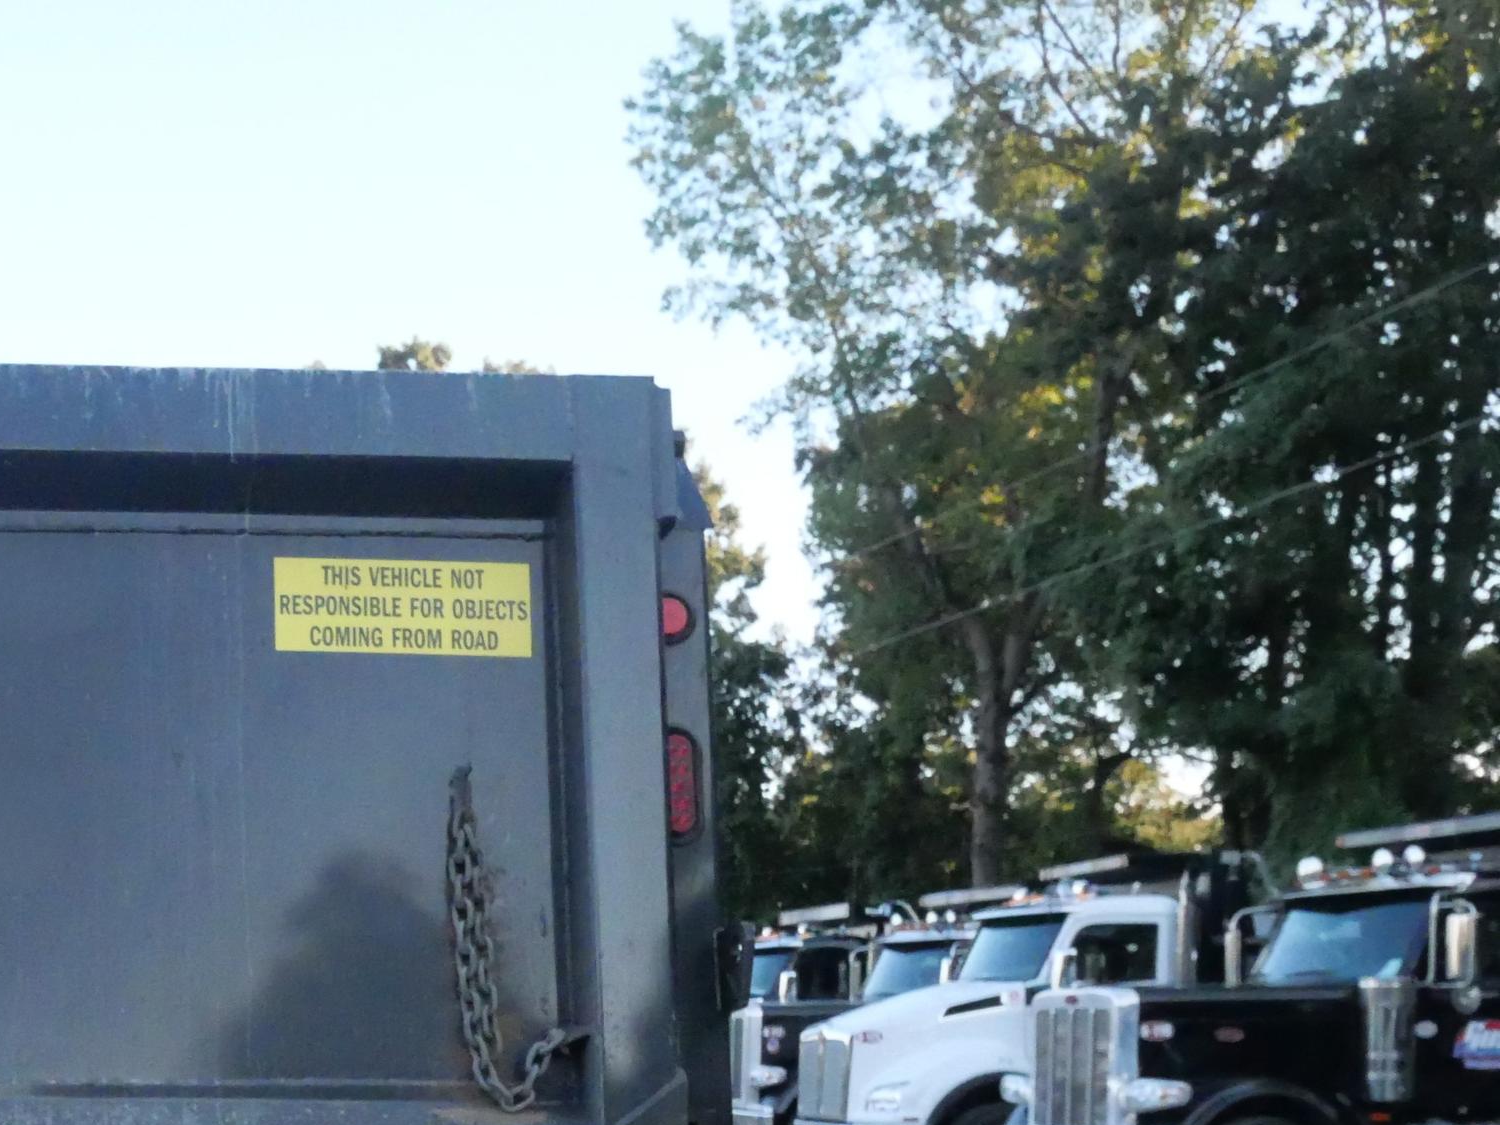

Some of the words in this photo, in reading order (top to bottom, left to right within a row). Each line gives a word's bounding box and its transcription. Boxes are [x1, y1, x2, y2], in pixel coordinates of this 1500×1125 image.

[322, 565, 362, 586] THIS
[369, 567, 442, 588] VEHICLE
[450, 569, 485, 589] NOT
[279, 594, 402, 618] RESPONSIBLE
[410, 598, 444, 619] FOR
[452, 599, 528, 621] OBJECTS
[309, 625, 383, 647] COMING
[392, 627, 443, 649] FROM
[451, 630, 499, 650] ROAD
